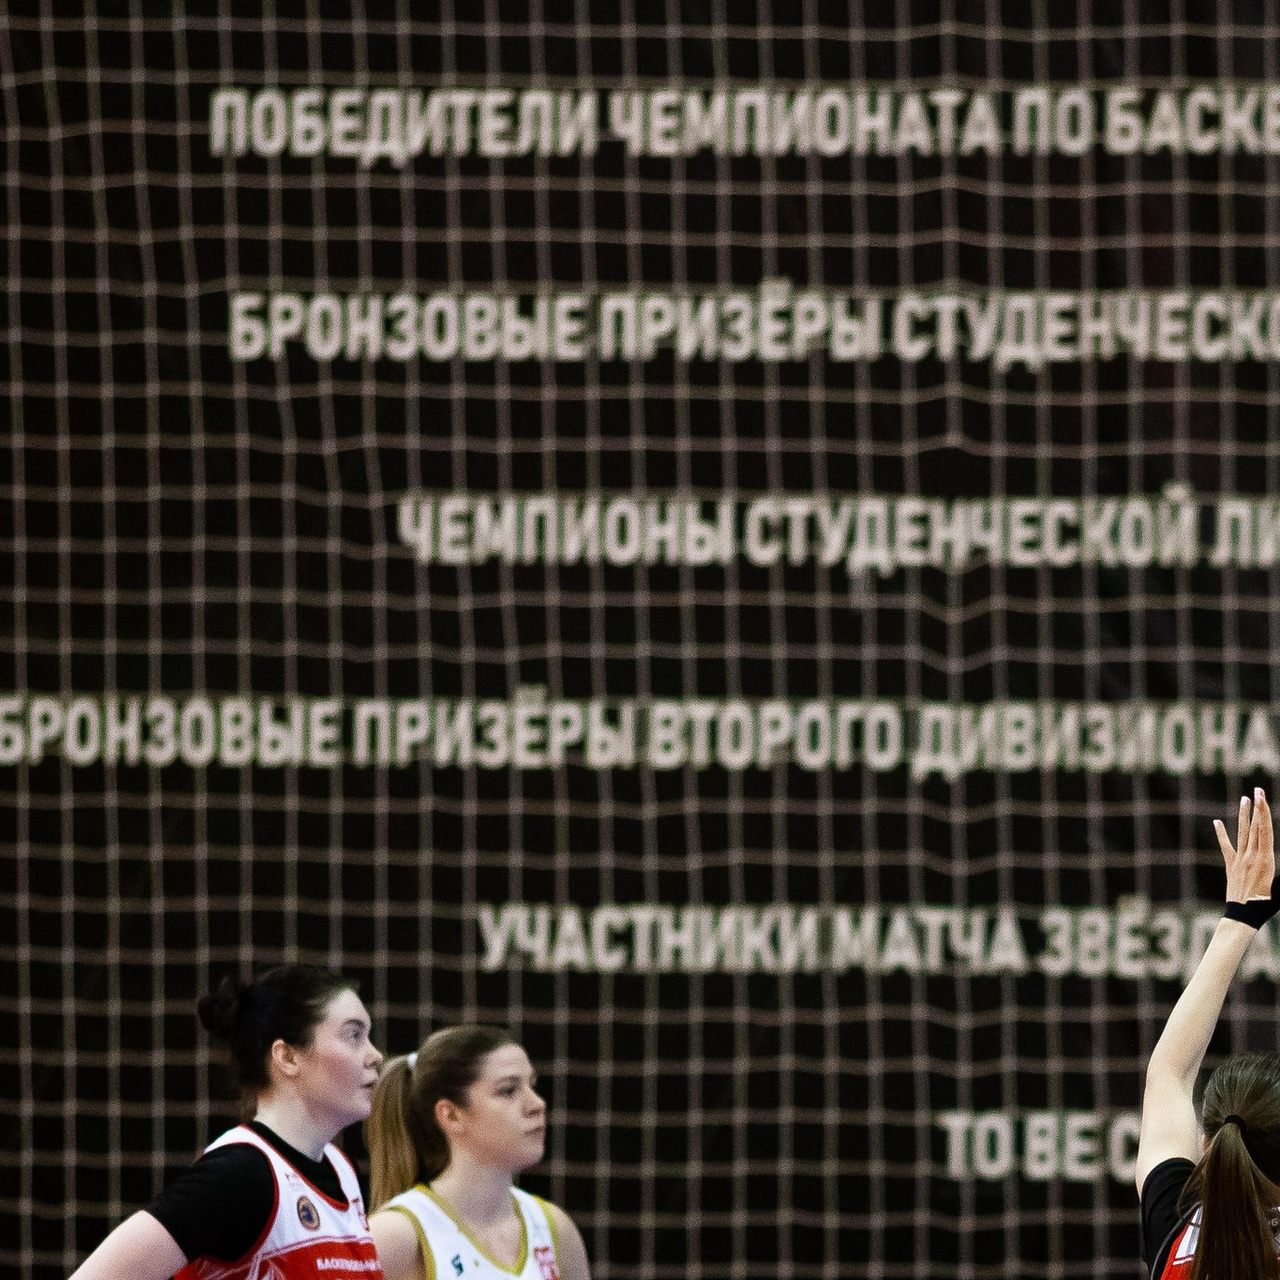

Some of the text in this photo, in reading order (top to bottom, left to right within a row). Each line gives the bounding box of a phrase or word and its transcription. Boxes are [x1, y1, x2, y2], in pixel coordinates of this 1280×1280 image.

[211, 89, 596, 164] ПОБЕДИТЕЛИ
[610, 87, 1000, 156] ЧЕМПИОНАТА
[1014, 86, 1092, 154] ПО
[231, 293, 586, 360] БРОНЗОВЫЕ
[599, 281, 881, 361] ПРИЗЁРЫ
[399, 495, 735, 565] ЧЕМПИОНЫ
[745, 484, 1197, 575] СТУДЕНЧЕСКОЙ
[0, 697, 340, 765] БРОНЗОВЫЕ
[354, 691, 636, 768] ПРИЗЁРЫ
[646, 699, 901, 770] ВТОРОГО
[479, 905, 819, 971] УЧАСТНИКИ
[831, 907, 1026, 971] МАТЧА
